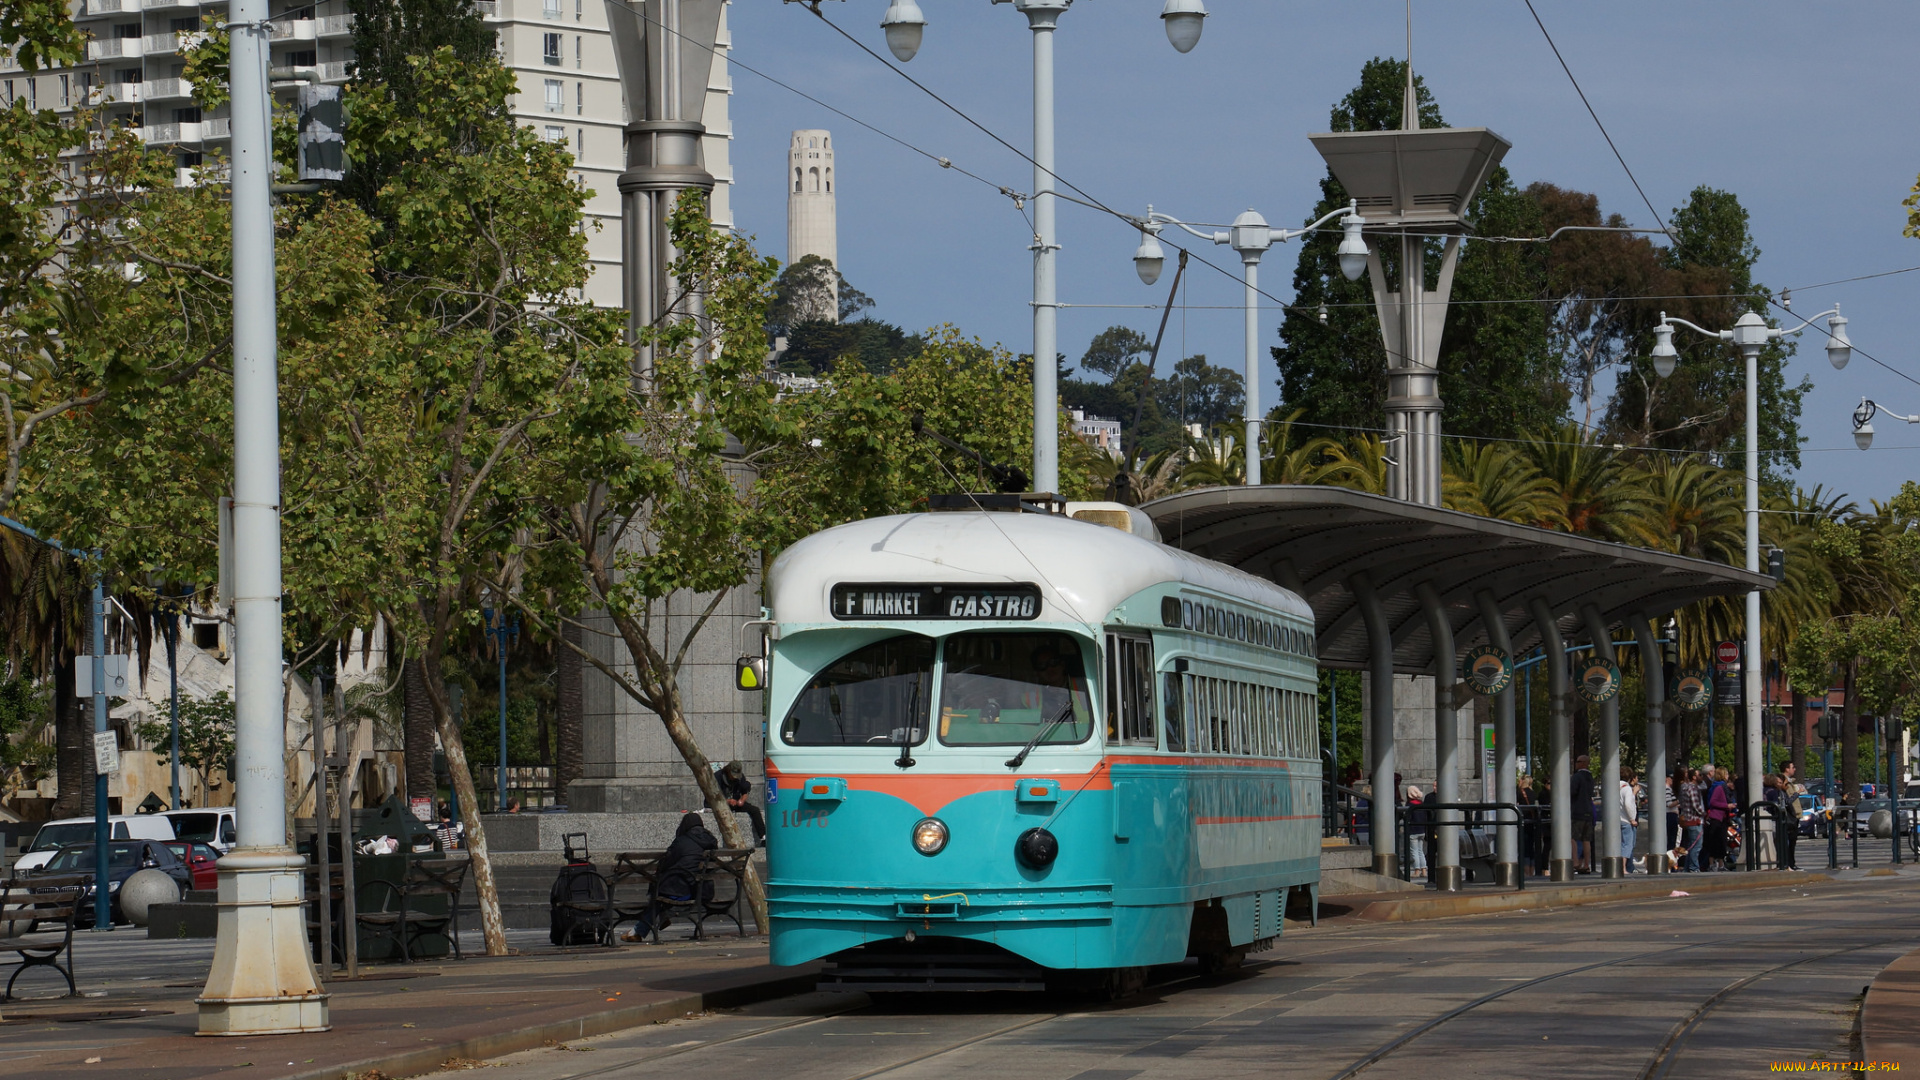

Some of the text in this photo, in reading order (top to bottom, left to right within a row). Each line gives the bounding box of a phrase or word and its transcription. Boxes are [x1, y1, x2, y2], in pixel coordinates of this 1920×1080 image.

[846, 592, 921, 615] F MARKET
[949, 595, 1036, 617] CASTRO
[1470, 646, 1505, 659] FERRY
[1466, 672, 1511, 694] TERMINAL
[1577, 682, 1619, 702] TERMINAL
[781, 808, 829, 828] 1076
